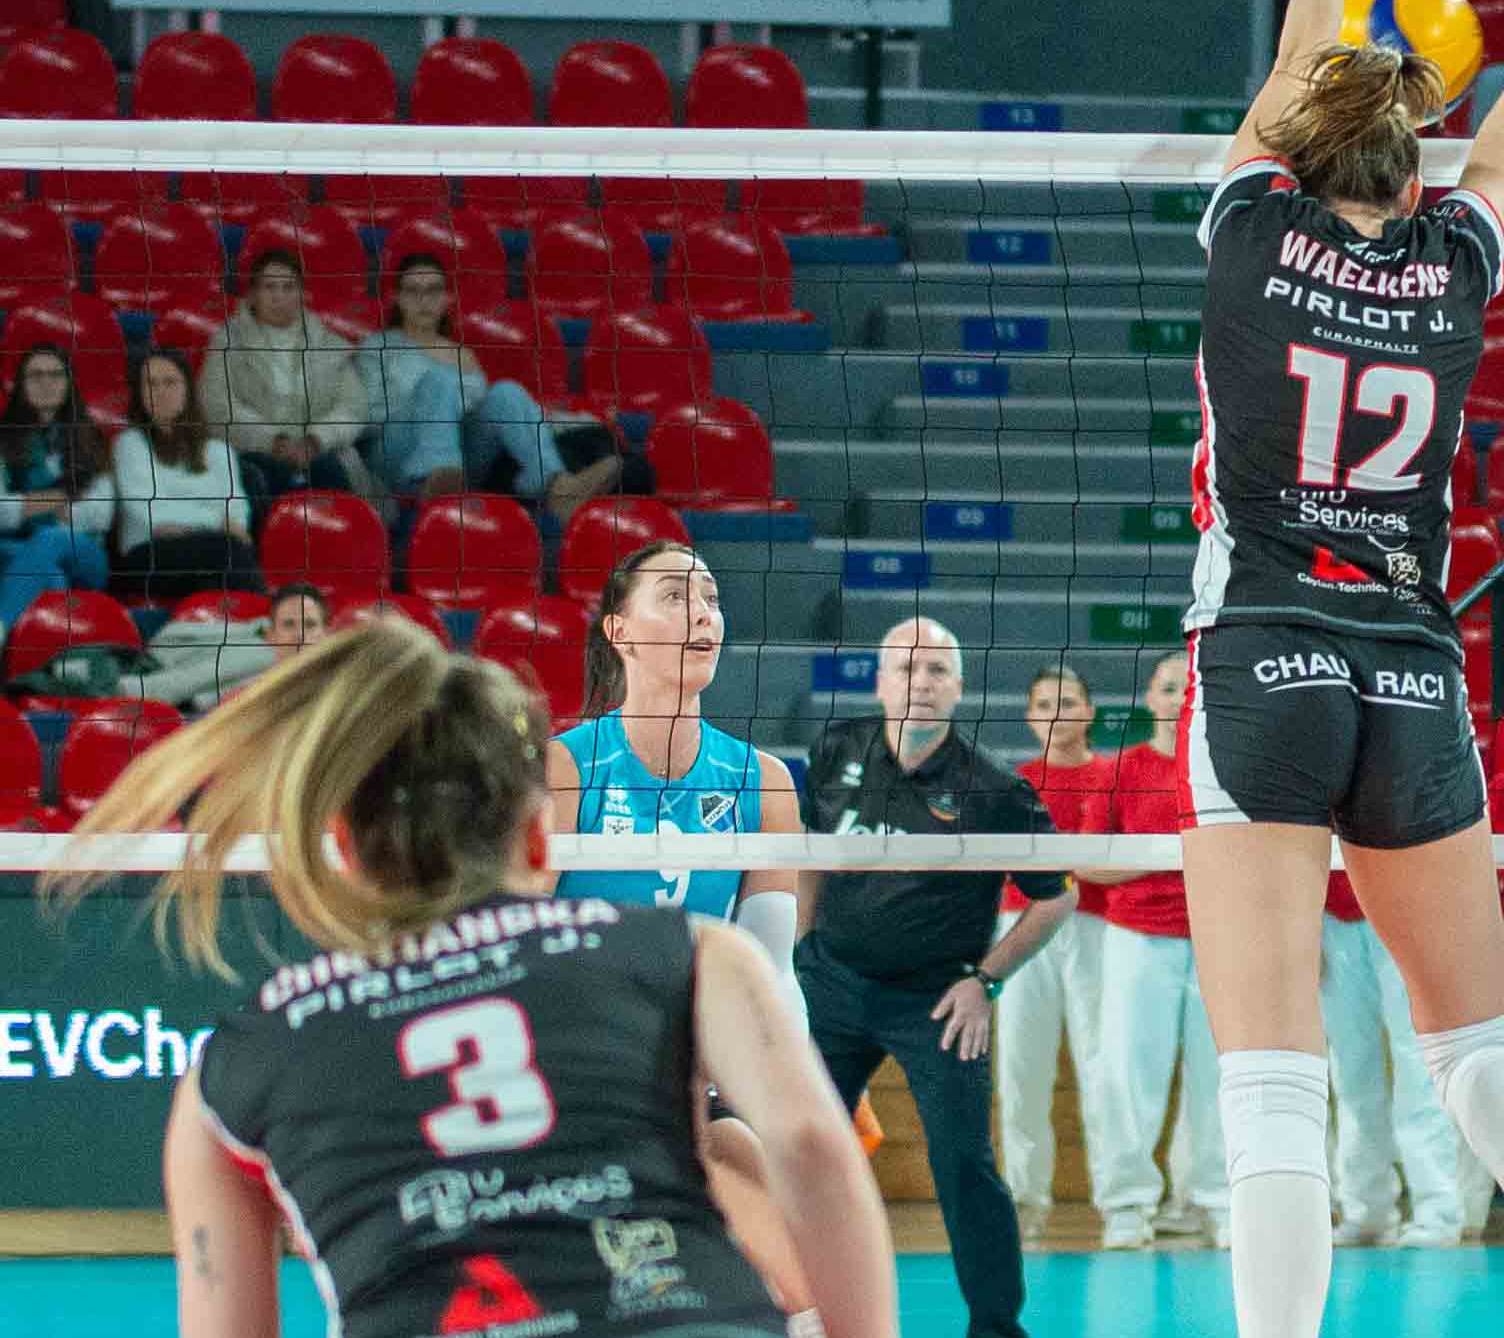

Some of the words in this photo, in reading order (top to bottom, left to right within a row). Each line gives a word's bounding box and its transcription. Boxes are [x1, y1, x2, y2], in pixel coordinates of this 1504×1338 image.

[1264, 275, 1416, 332] PIRLOT
[1429, 309, 1454, 333] J.
[1284, 342, 1438, 493] 12
[1299, 500, 1409, 533] Services
[1253, 652, 1352, 685] CHAU
[1375, 670, 1446, 700] RACI
[395, 994, 558, 1158] 3
